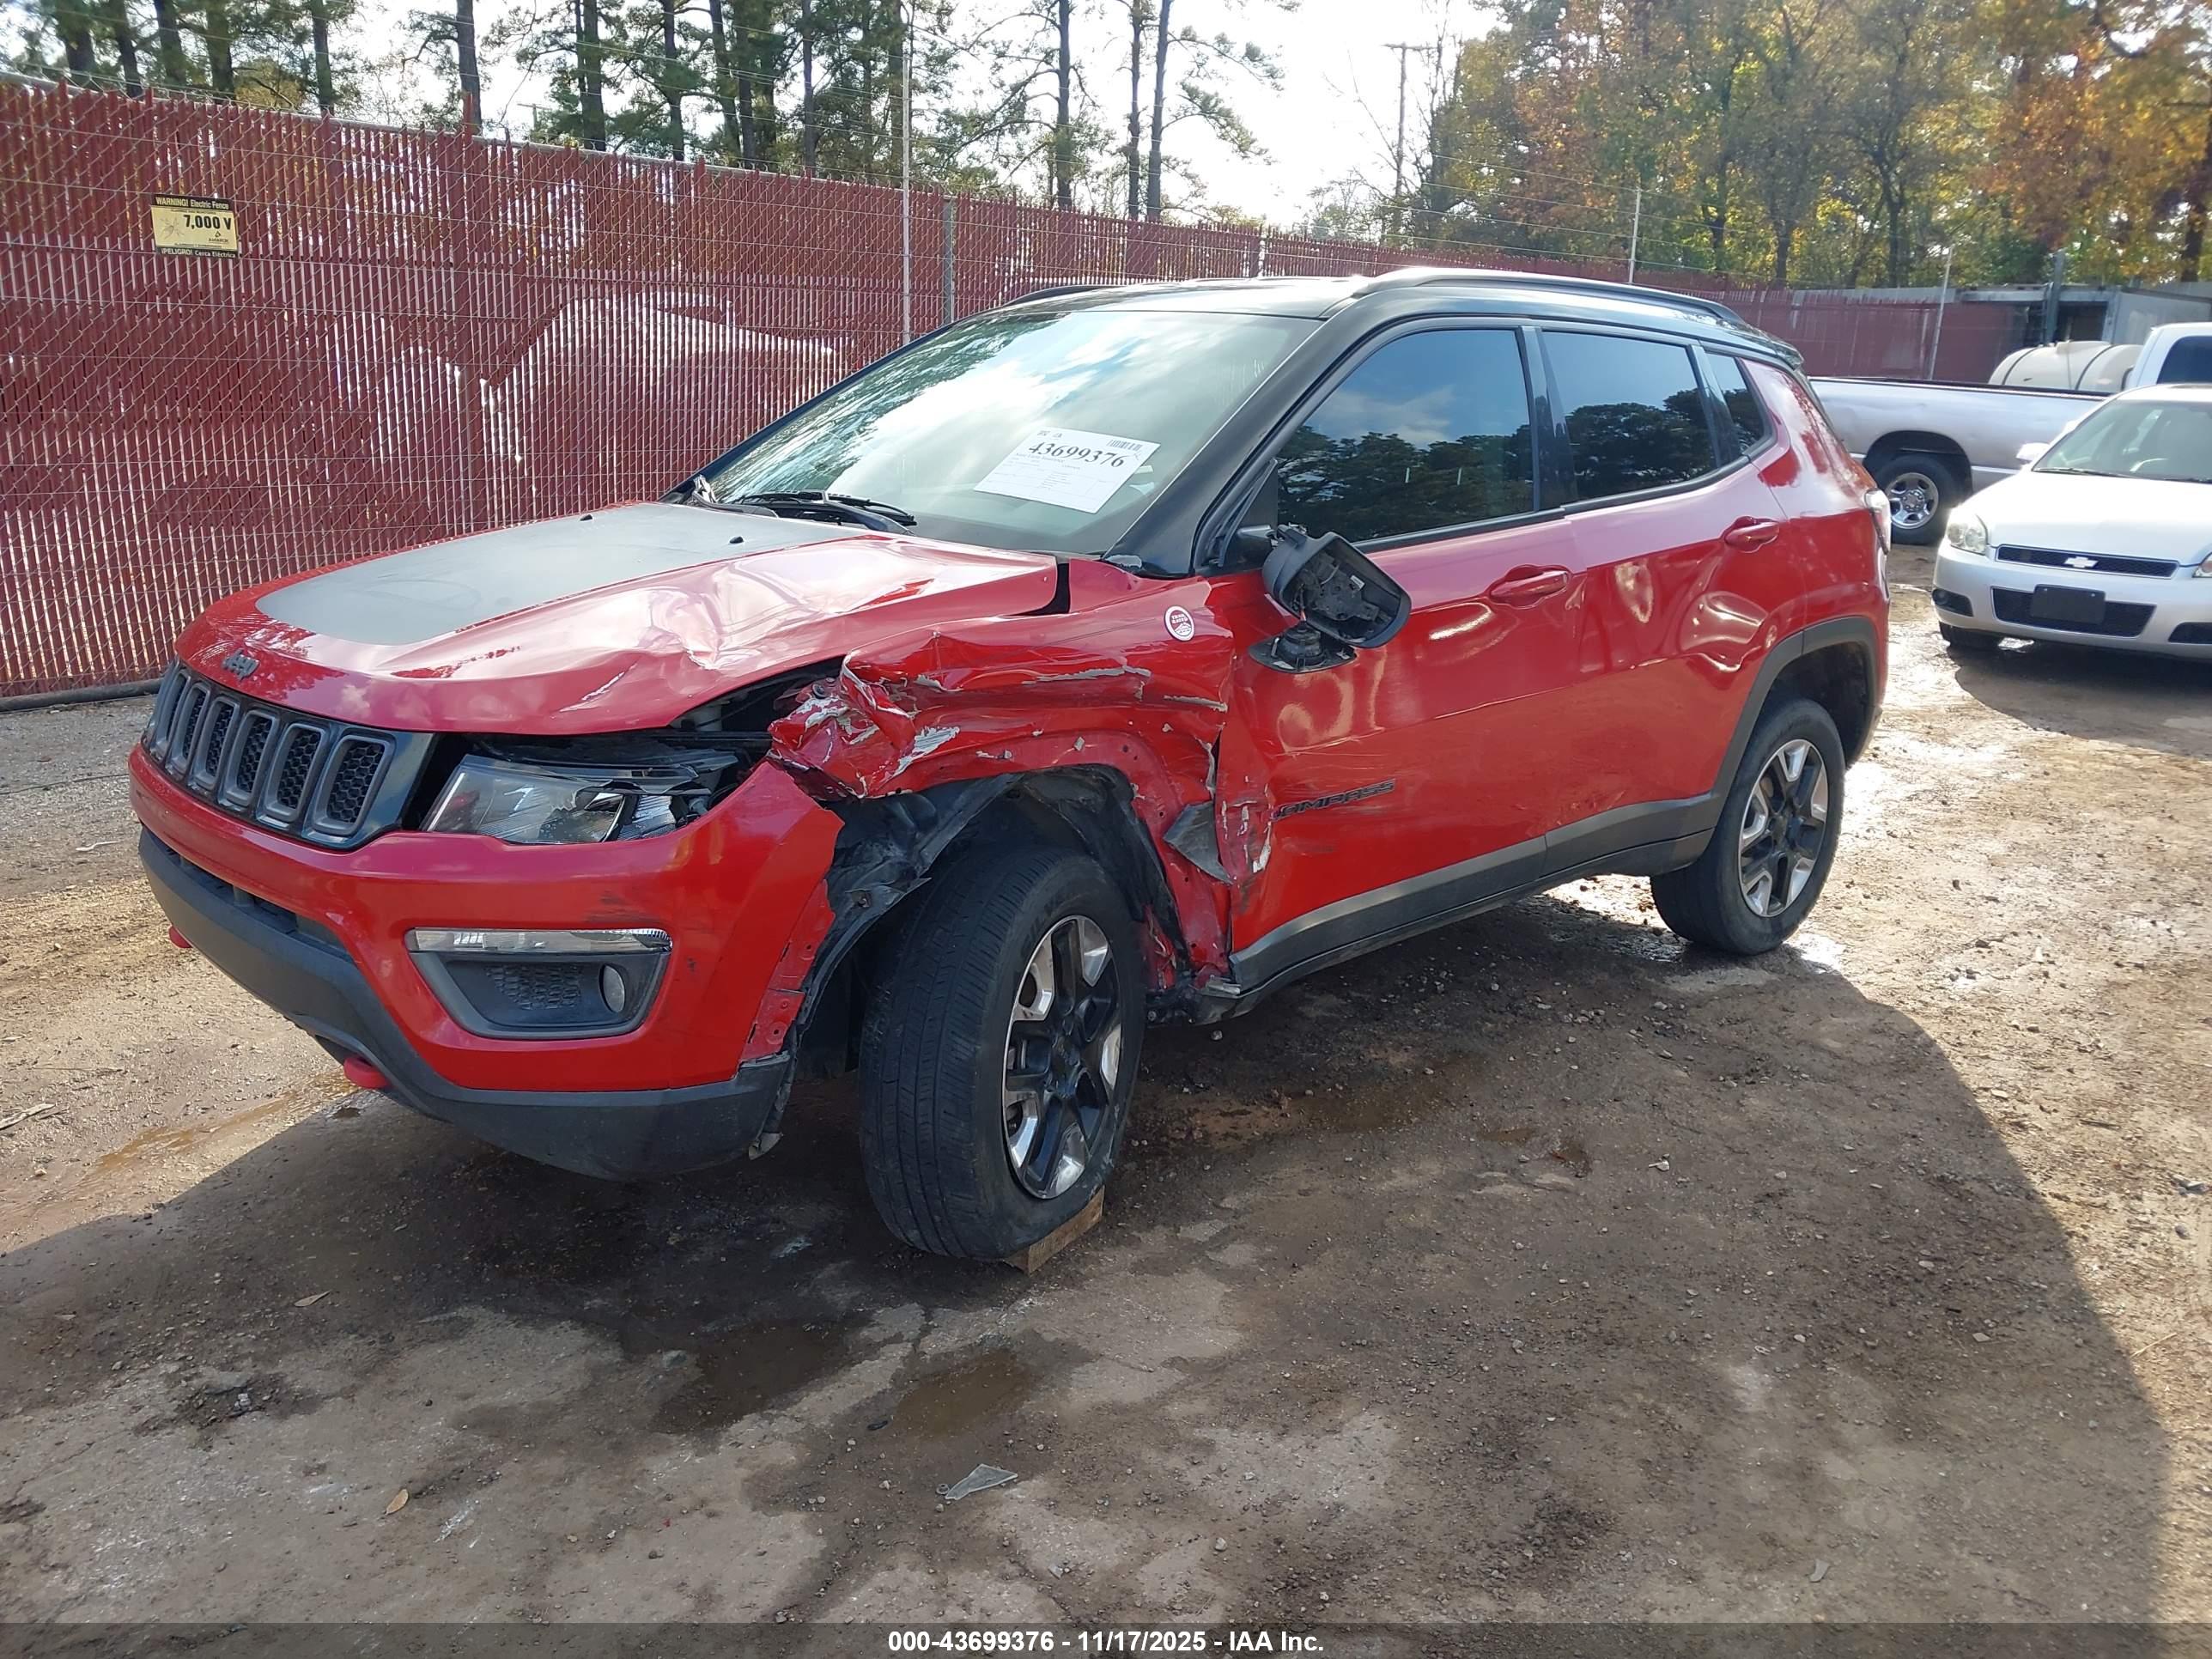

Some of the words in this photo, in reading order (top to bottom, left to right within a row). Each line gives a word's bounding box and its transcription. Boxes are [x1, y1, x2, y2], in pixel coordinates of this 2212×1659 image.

[156, 197, 188, 206] WARNING!
[190, 199, 211, 209] Electric
[183, 214, 221, 229] 7,000
[223, 217, 232, 230] V
[1029, 441, 1129, 468] 43699376
[222, 647, 260, 681] Jeep
